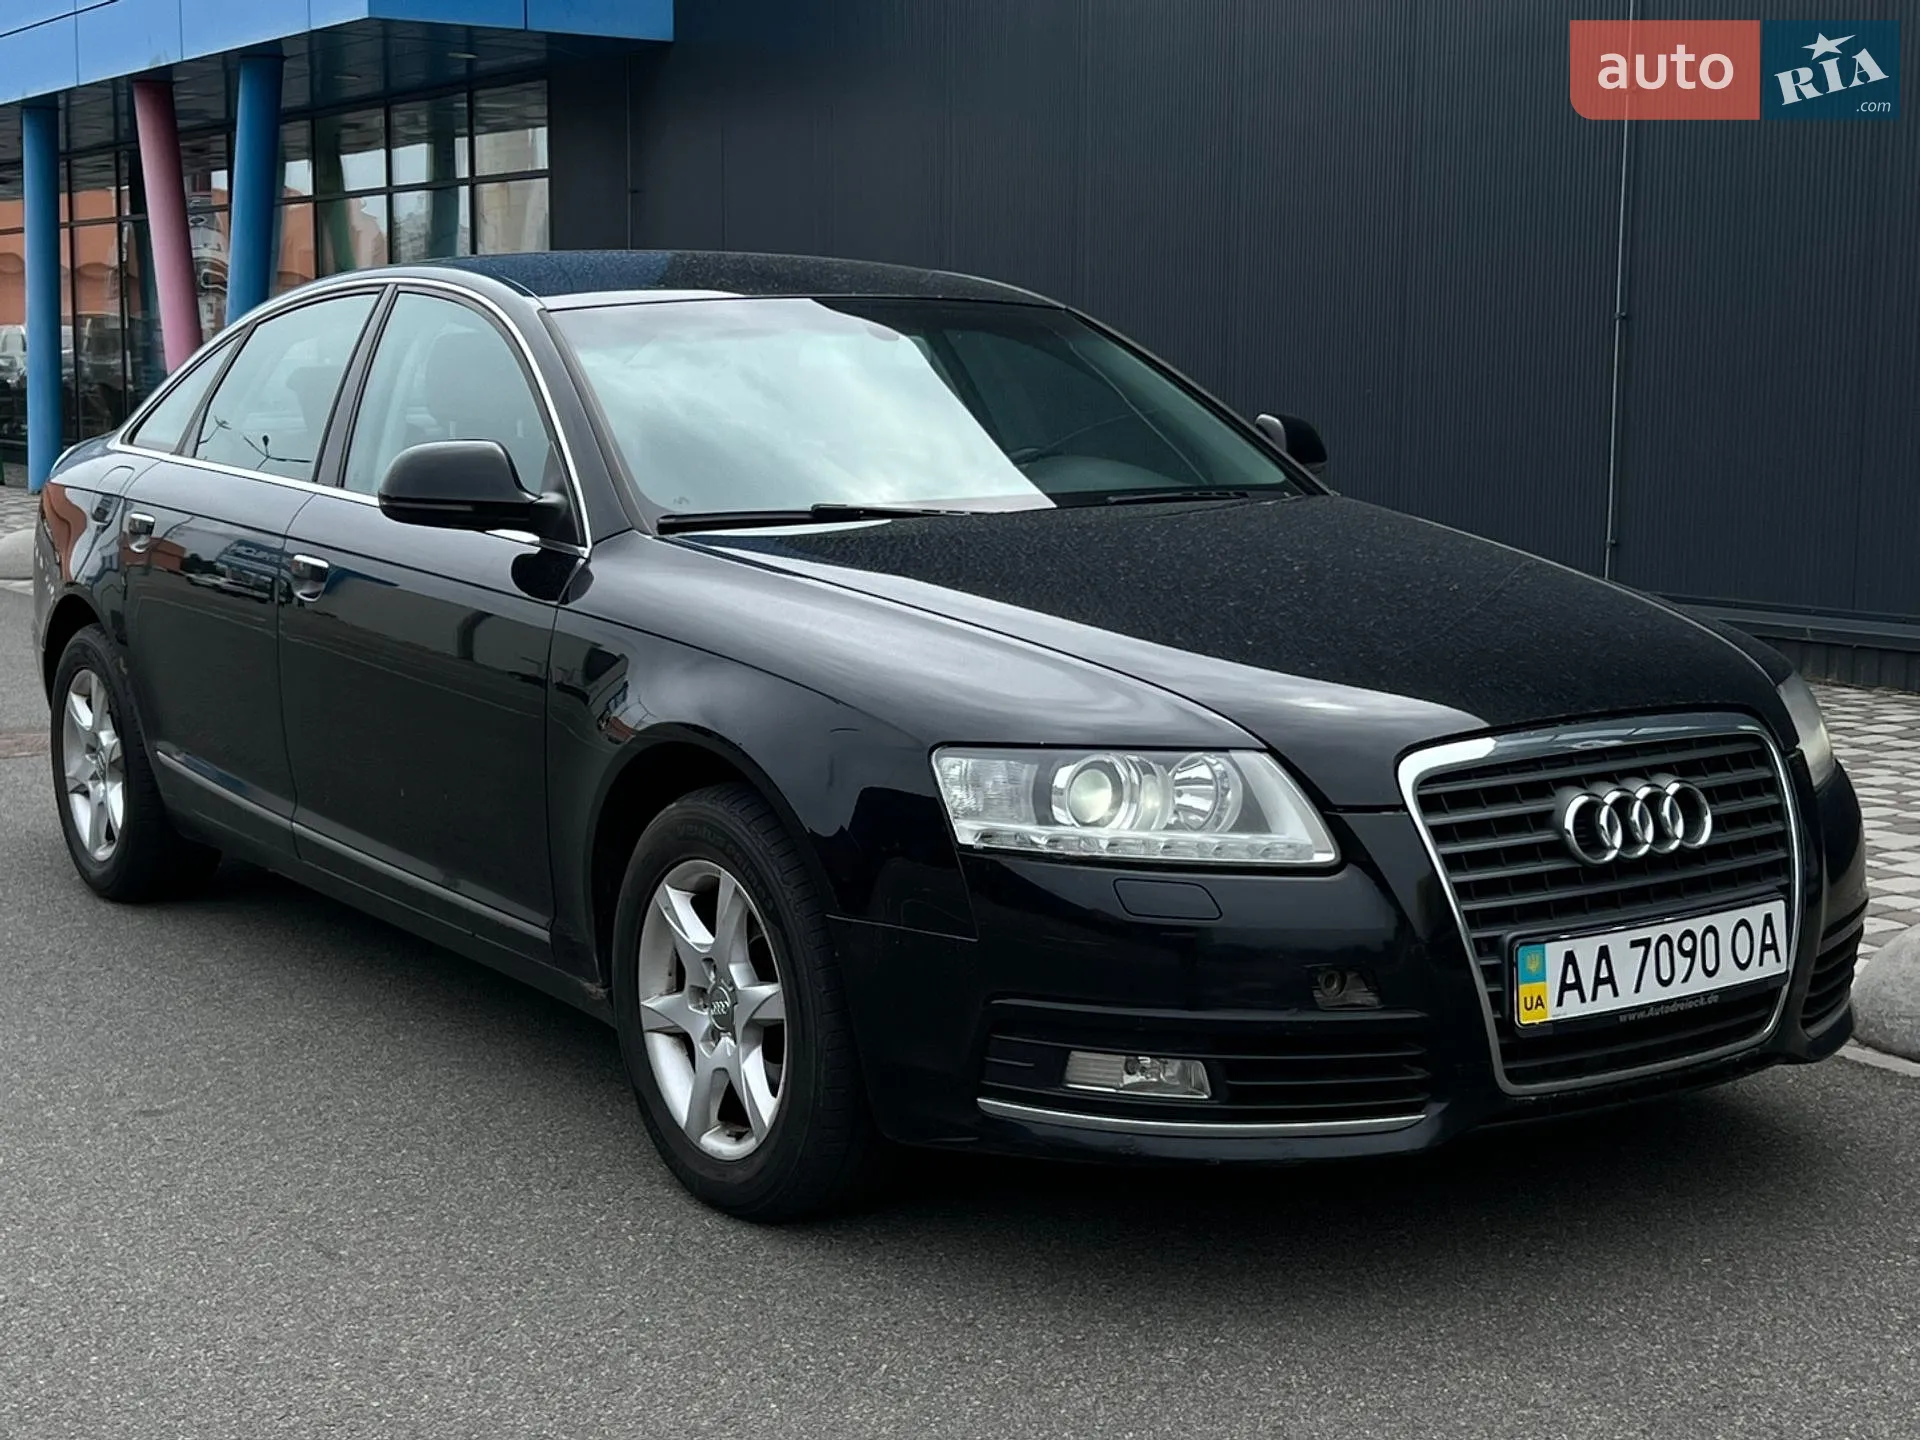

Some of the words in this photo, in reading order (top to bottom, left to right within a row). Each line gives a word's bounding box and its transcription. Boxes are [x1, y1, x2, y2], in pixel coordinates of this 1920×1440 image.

[1556, 944, 1620, 1008] AA
[1630, 924, 1720, 994] 7090
[1731, 912, 1782, 971] OA
[1523, 994, 1546, 1011] UA
